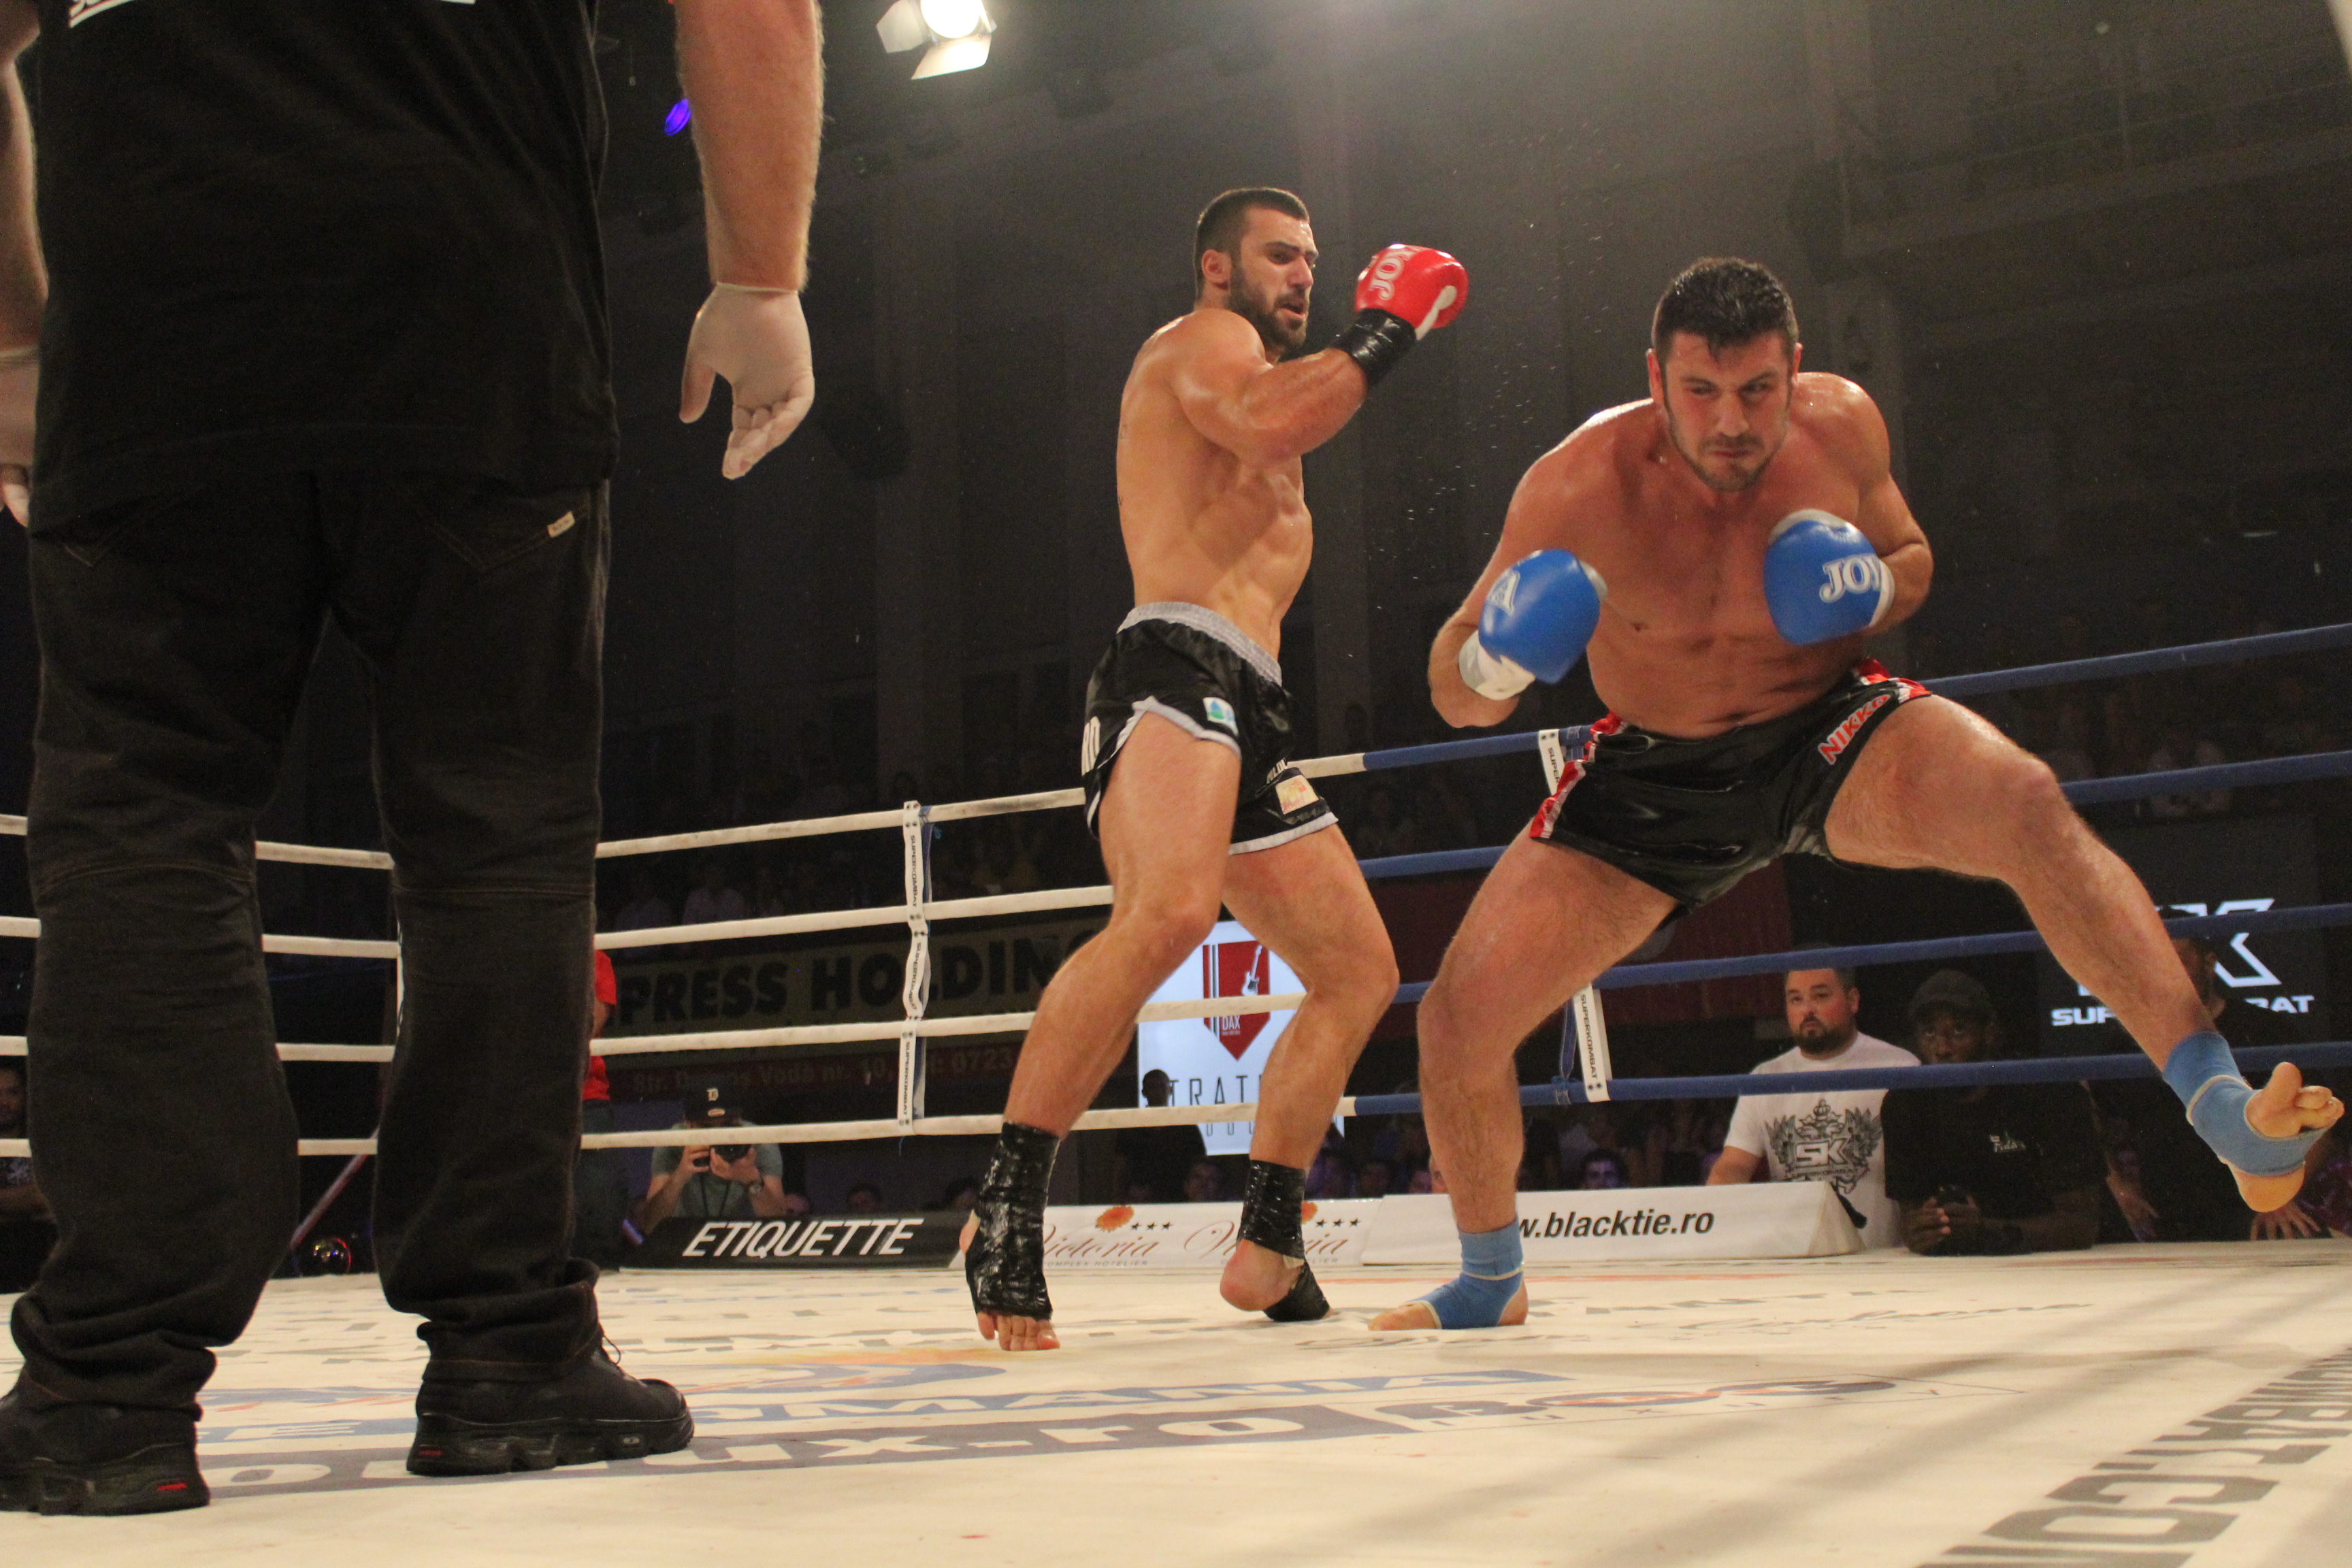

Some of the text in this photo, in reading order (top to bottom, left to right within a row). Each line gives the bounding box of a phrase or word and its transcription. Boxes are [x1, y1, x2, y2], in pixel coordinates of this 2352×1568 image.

[619, 930, 1094, 1025] PRESS HODIN
[1222, 1015, 1241, 1030] DAX
[1580, 994, 1598, 1080] SUPERKOMBAT
[682, 1218, 924, 1258] ETIQUETTE
